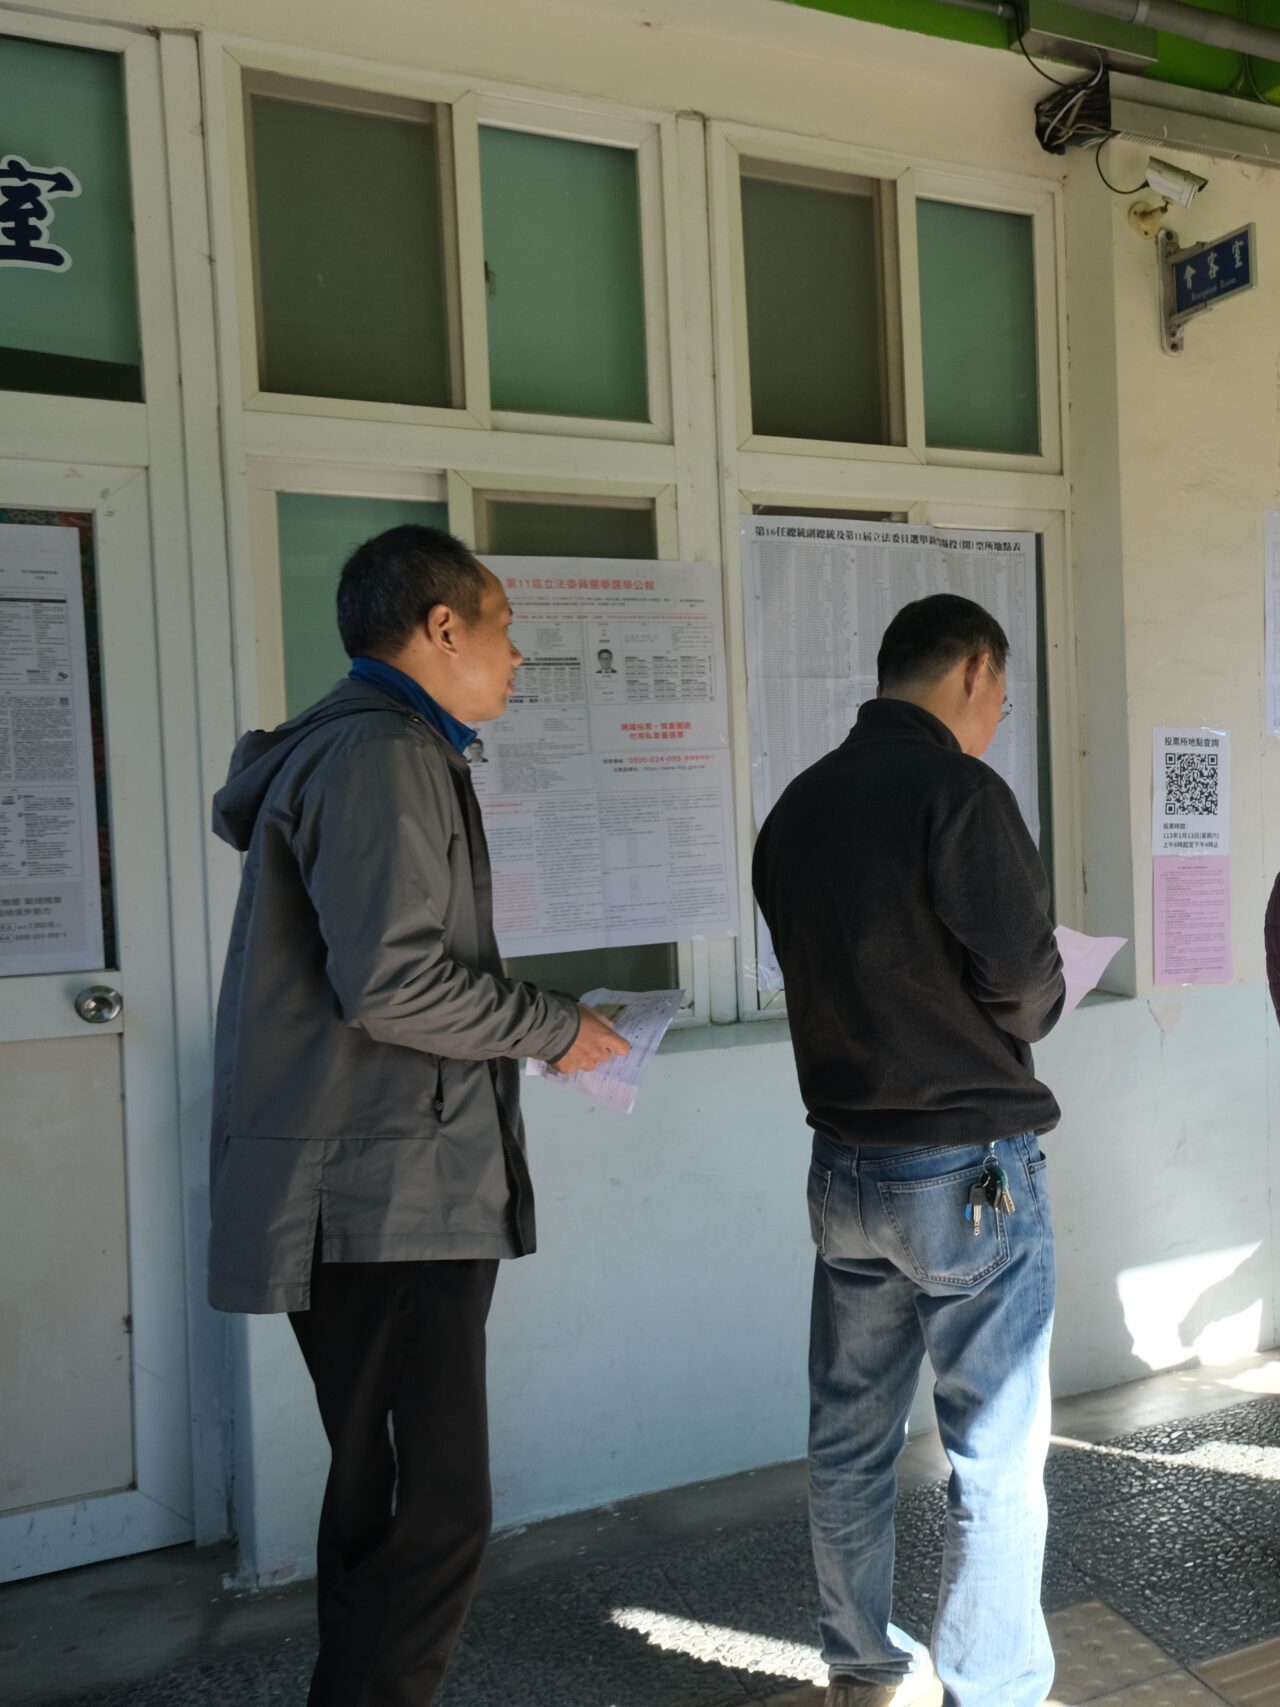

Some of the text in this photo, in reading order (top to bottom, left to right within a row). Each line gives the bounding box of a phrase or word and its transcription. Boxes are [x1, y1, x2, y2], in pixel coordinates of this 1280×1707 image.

[0, 158, 76, 268] 室
[1164, 737, 1220, 748] 投票所地點查詢
